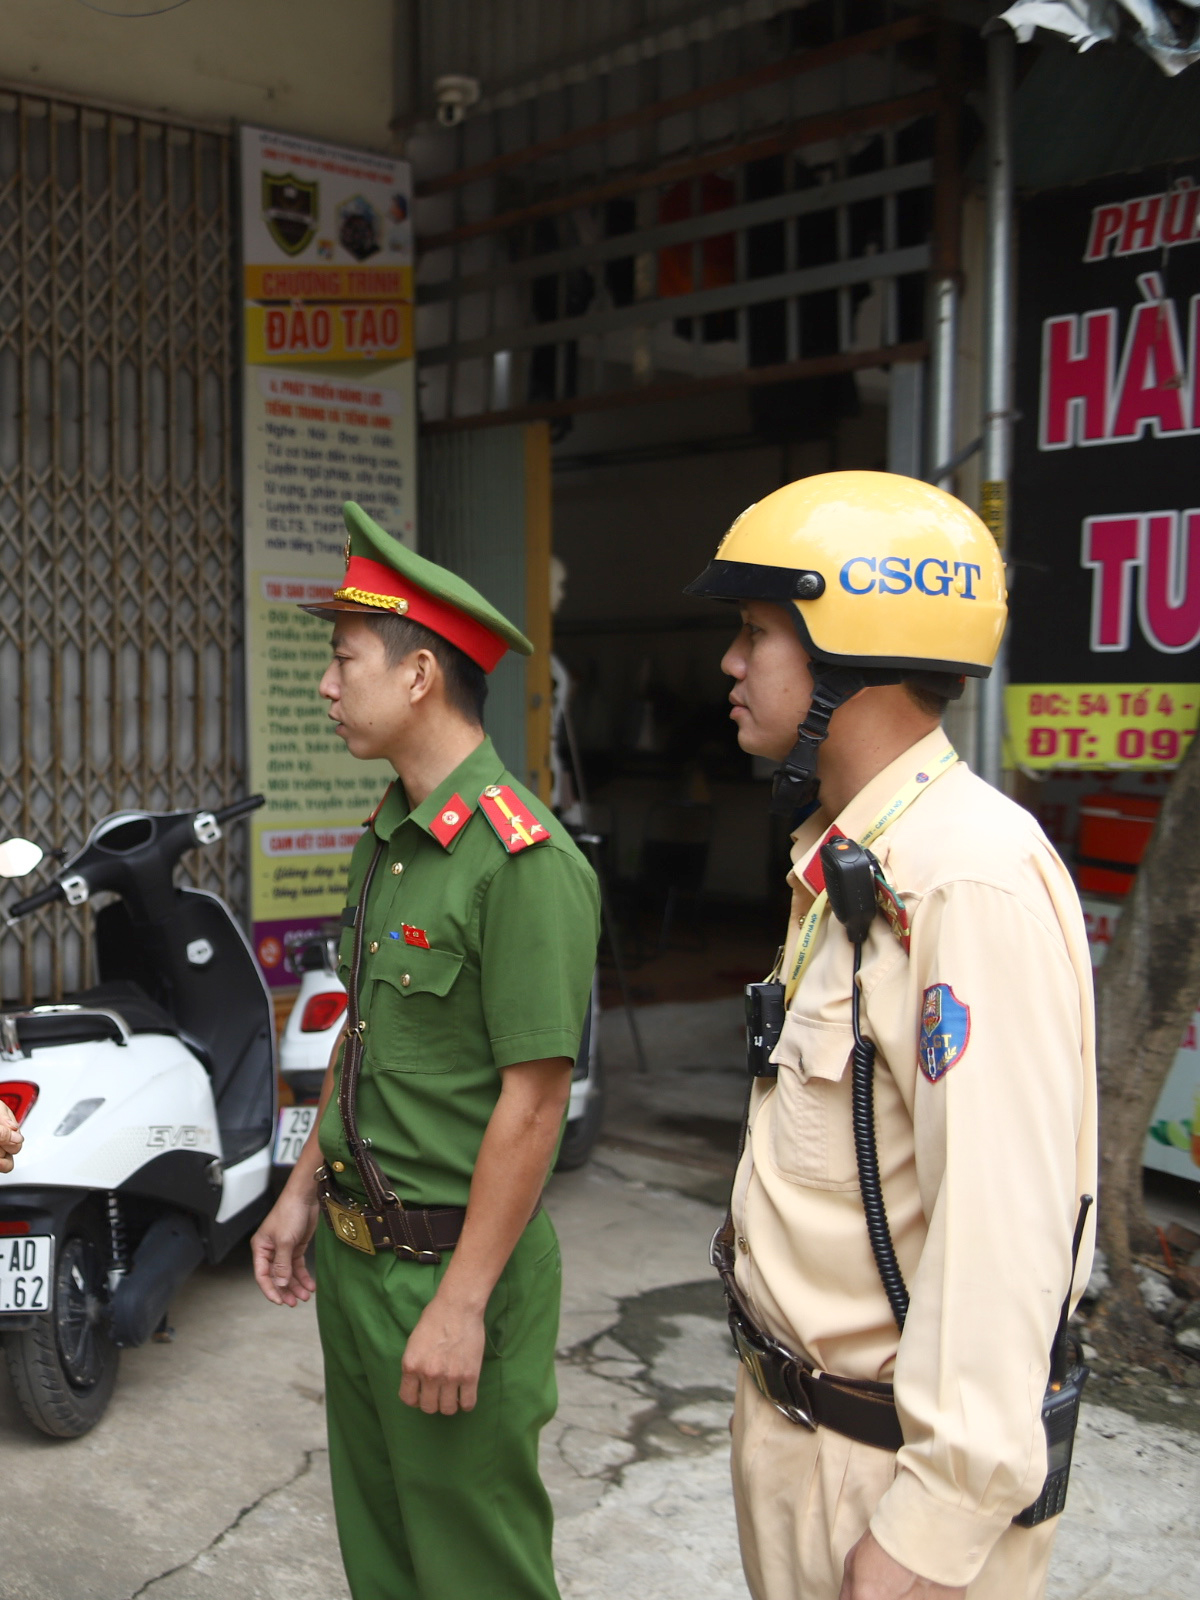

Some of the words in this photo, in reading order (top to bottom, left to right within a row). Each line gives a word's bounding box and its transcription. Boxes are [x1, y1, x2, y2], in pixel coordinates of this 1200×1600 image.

[265, 300, 331, 351] ĐÀO
[341, 308, 401, 357] TẠO
[1038, 271, 1200, 450] HÀ
[839, 557, 981, 600] CSGT
[1077, 693, 1110, 717] 54
[1156, 694, 1175, 717] 4
[1026, 727, 1098, 758] ĐT:
